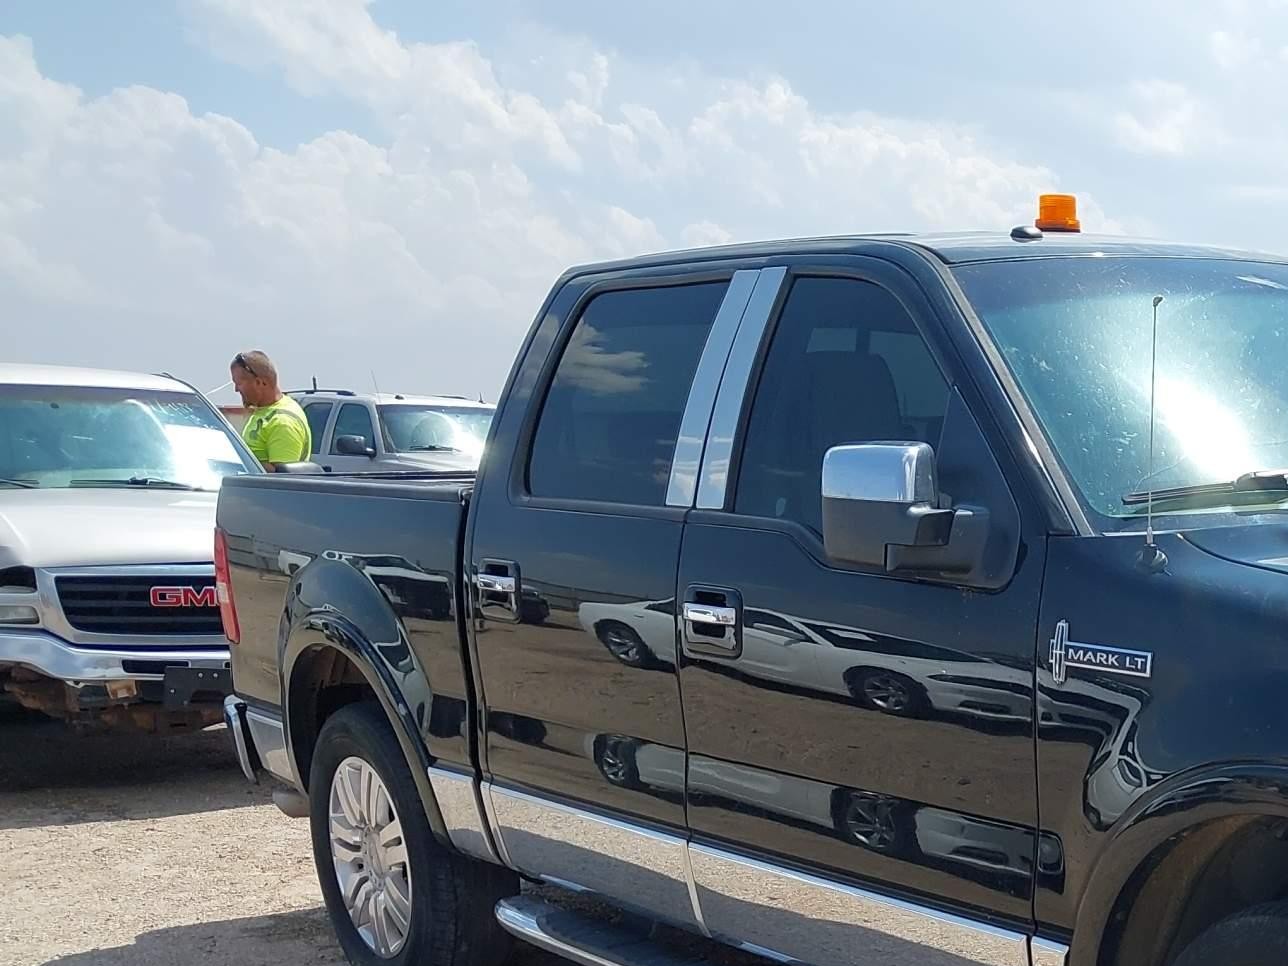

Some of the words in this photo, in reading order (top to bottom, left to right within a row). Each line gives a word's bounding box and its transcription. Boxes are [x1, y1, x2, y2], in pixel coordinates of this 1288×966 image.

[150, 586, 220, 606] GM
[1068, 648, 1120, 666] MARK
[1126, 656, 1145, 669] LT
